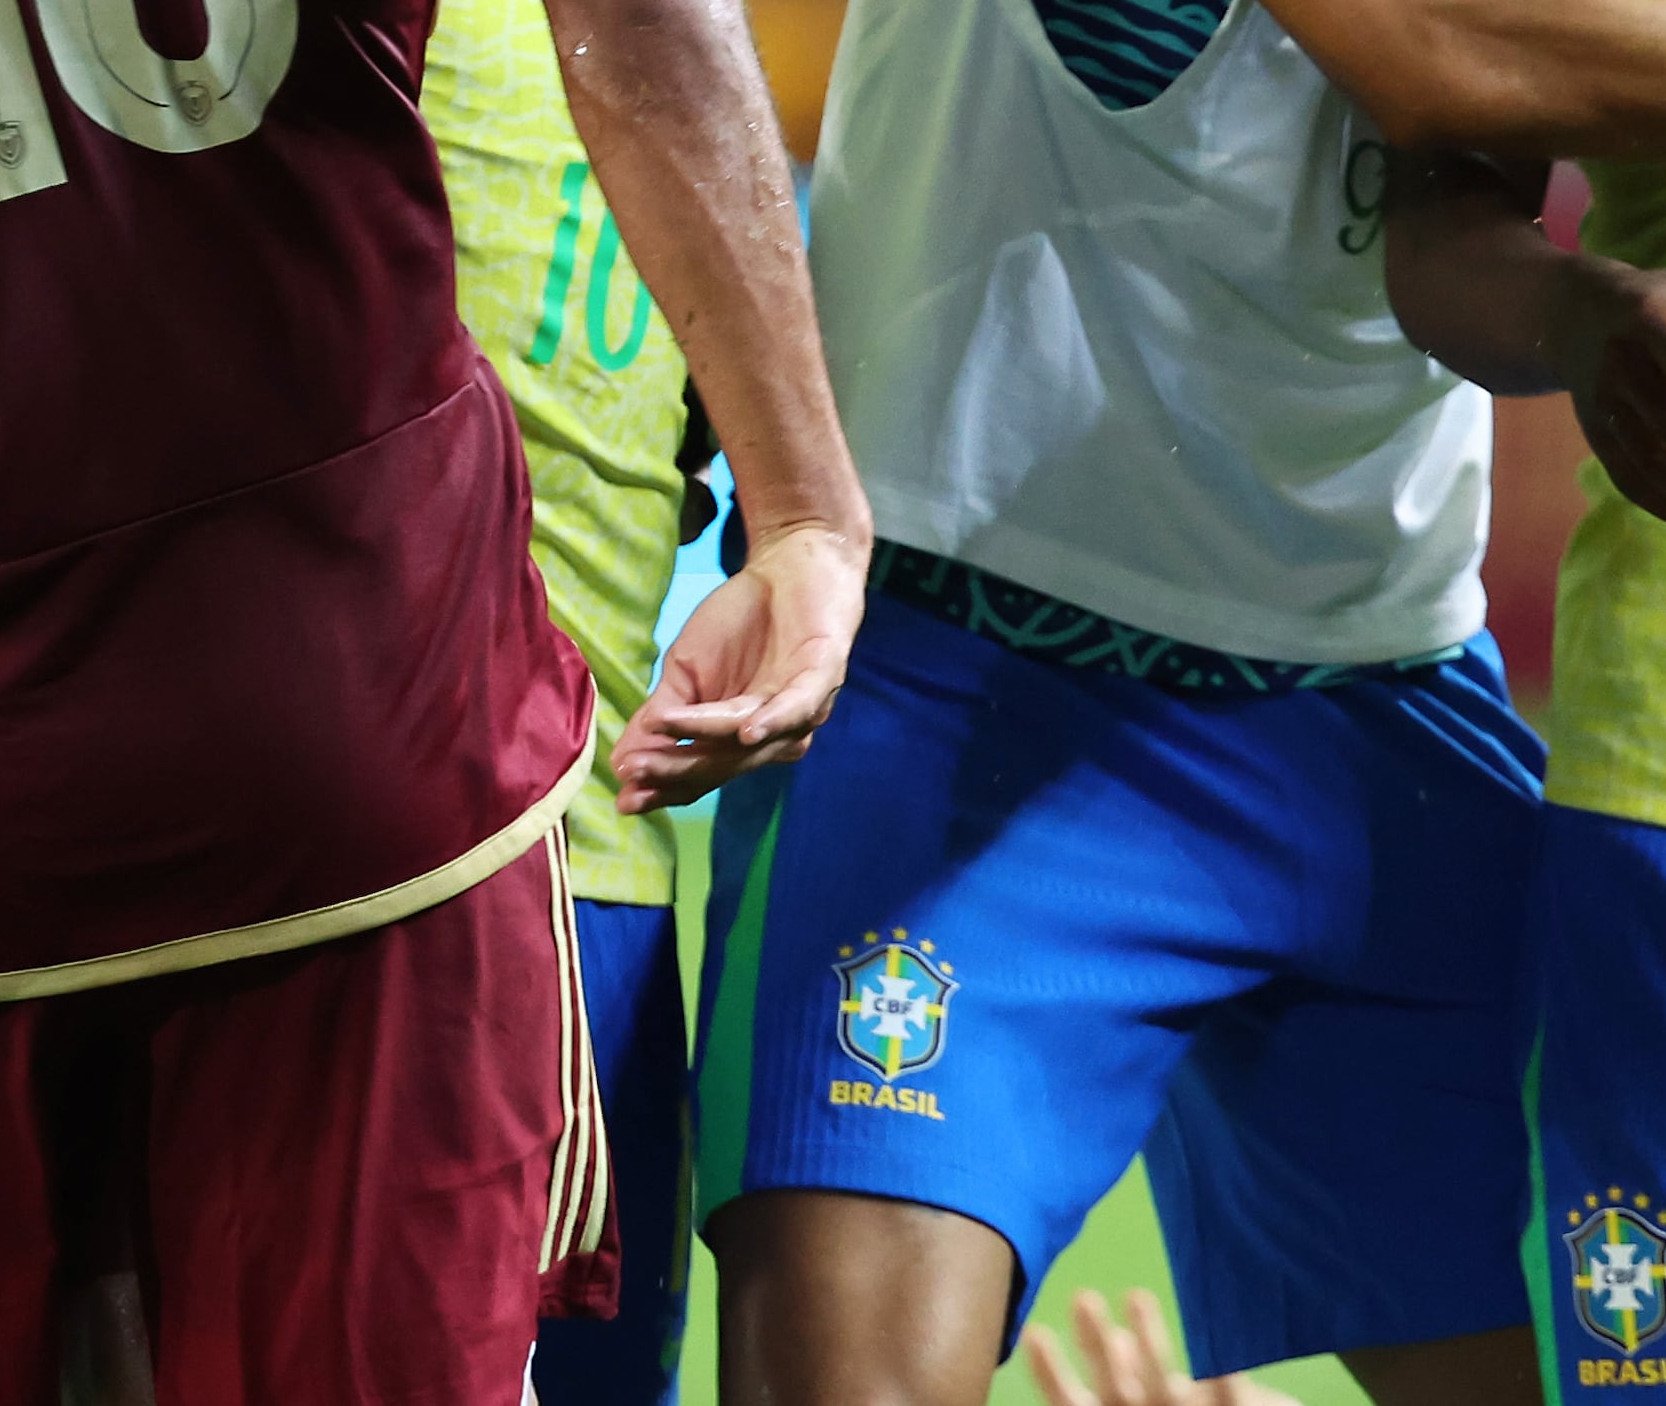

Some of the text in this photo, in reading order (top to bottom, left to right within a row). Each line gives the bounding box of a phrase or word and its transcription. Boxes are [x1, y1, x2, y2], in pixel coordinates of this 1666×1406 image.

[529, 162, 653, 372] 10
[873, 997, 913, 1014] CBF
[829, 1080, 946, 1121] BRASIL
